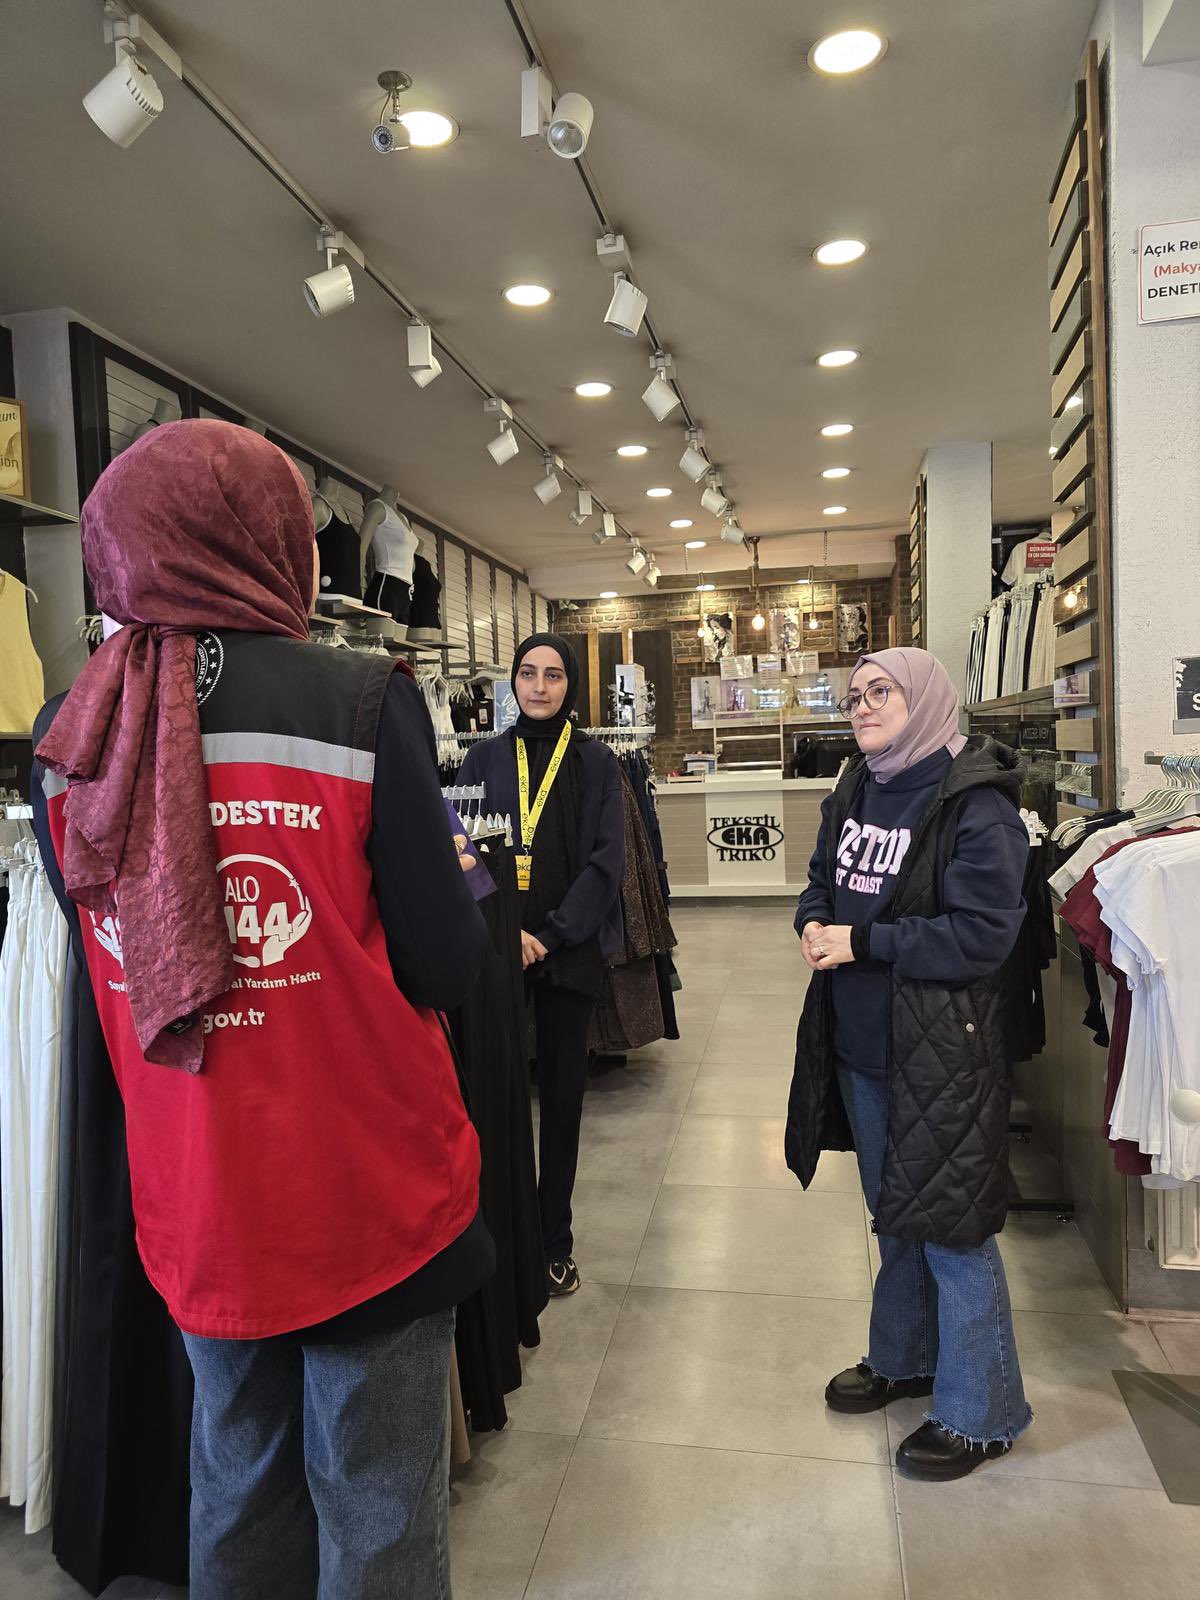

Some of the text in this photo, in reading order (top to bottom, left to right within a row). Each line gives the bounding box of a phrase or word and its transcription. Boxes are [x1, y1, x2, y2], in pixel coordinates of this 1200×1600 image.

[1144, 241, 1176, 259] Açık
[519, 775, 527, 793] eka
[208, 799, 323, 831] DESTEK
[710, 814, 780, 830] TEKSTİL
[722, 827, 769, 846] EKA
[225, 875, 260, 903] ALO
[848, 873, 883, 895] COAST
[245, 977, 288, 989] Yardım
[290, 971, 322, 986] Hattı
